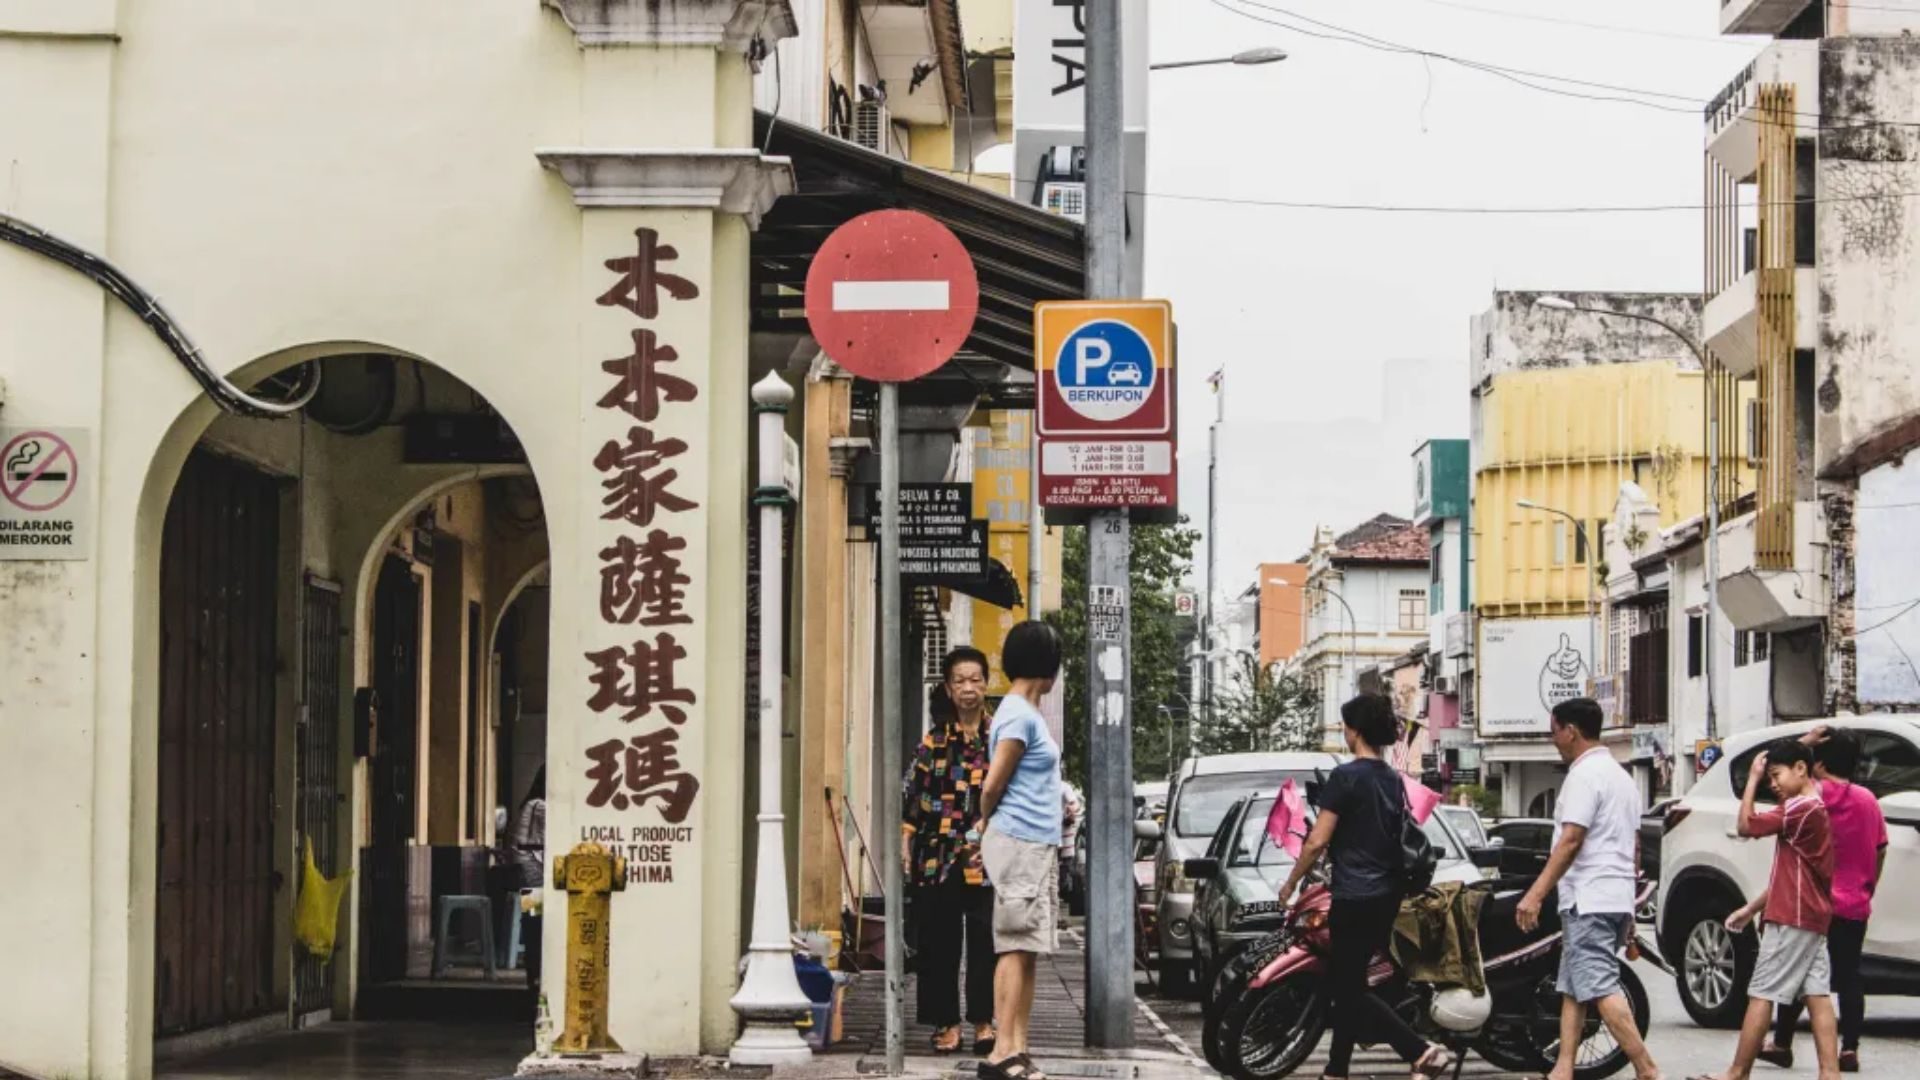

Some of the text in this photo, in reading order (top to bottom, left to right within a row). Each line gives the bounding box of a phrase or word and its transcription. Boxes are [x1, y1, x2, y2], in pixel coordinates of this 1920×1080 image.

[1076, 337, 1112, 386] P
[1068, 390, 1143, 401] BERKUPON
[900, 489, 929, 501] SELVA
[1046, 495, 1084, 504] KECUALI
[1089, 495, 1114, 504] AHAD
[0, 520, 74, 531] DILARANG
[1104, 520, 1121, 534] 26
[0, 534, 73, 545] MEROKOK
[581, 826, 694, 842] LOCAL PRODUCT
